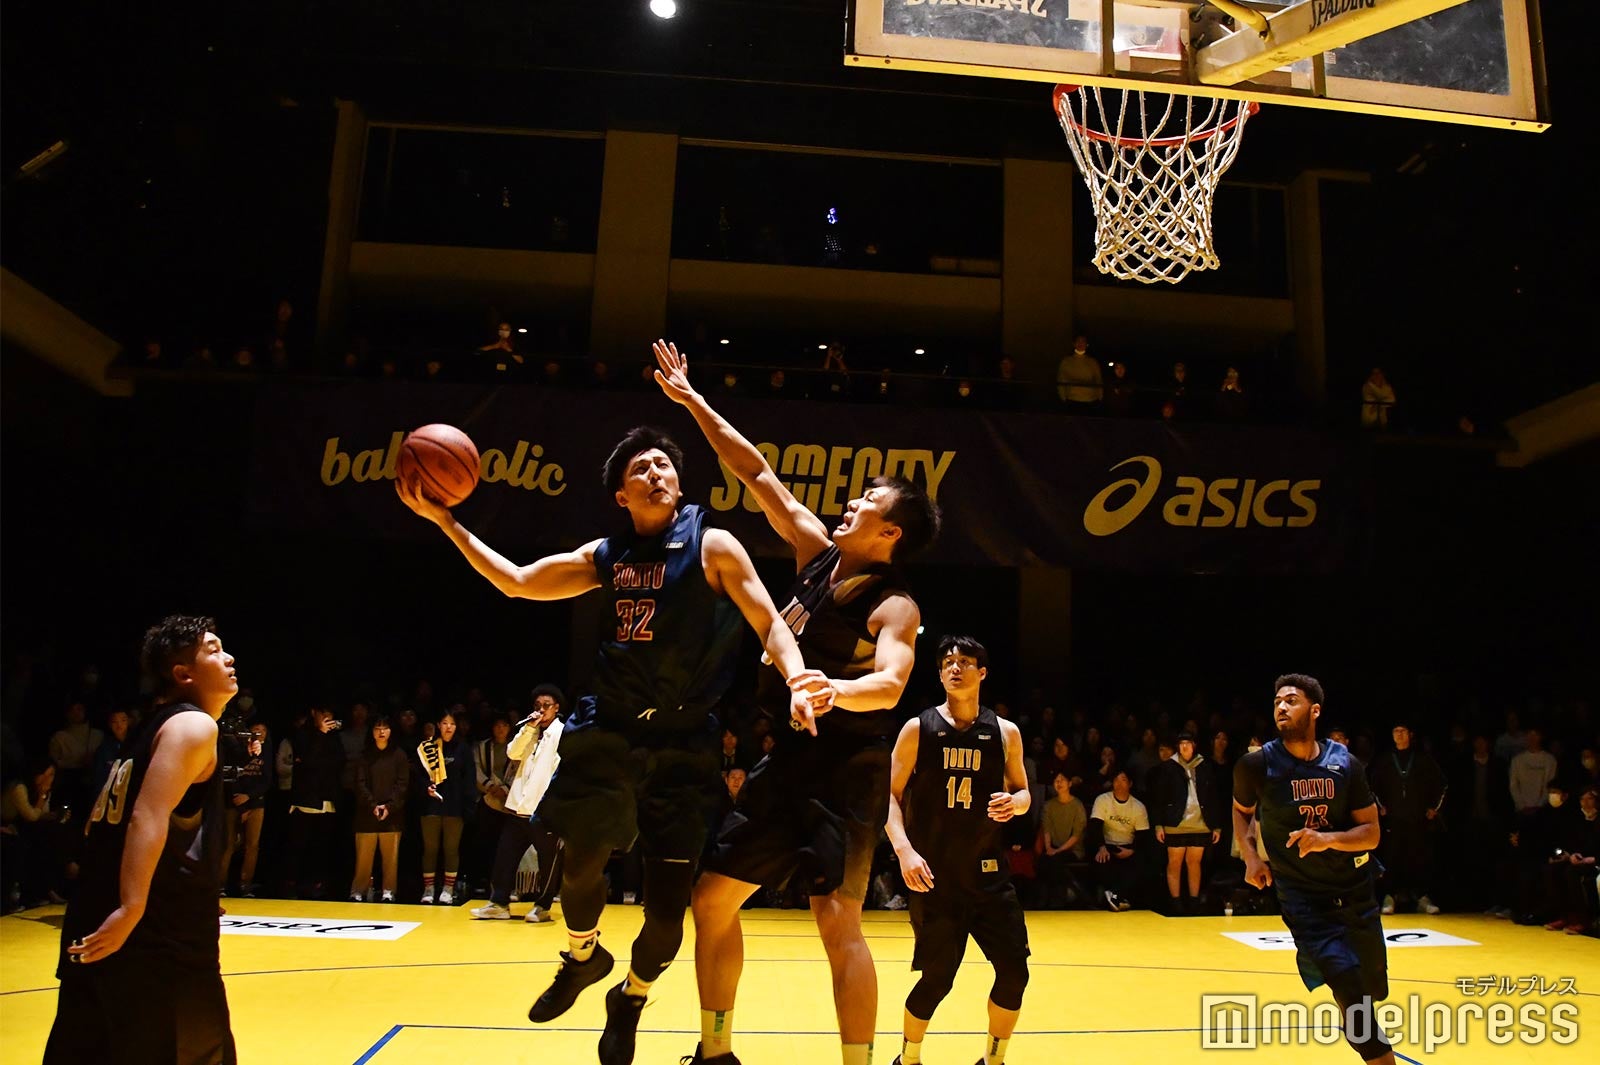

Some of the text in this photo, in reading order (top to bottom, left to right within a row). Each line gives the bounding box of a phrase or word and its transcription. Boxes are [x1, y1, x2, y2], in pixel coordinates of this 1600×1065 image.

[321, 431, 567, 496] balolic
[1163, 476, 1321, 528] asics
[616, 599, 656, 642] 32
[943, 747, 982, 772] TOKYO
[946, 776, 972, 809] 14
[1291, 778, 1335, 801] TOKYO
[1299, 804, 1329, 829] 23
